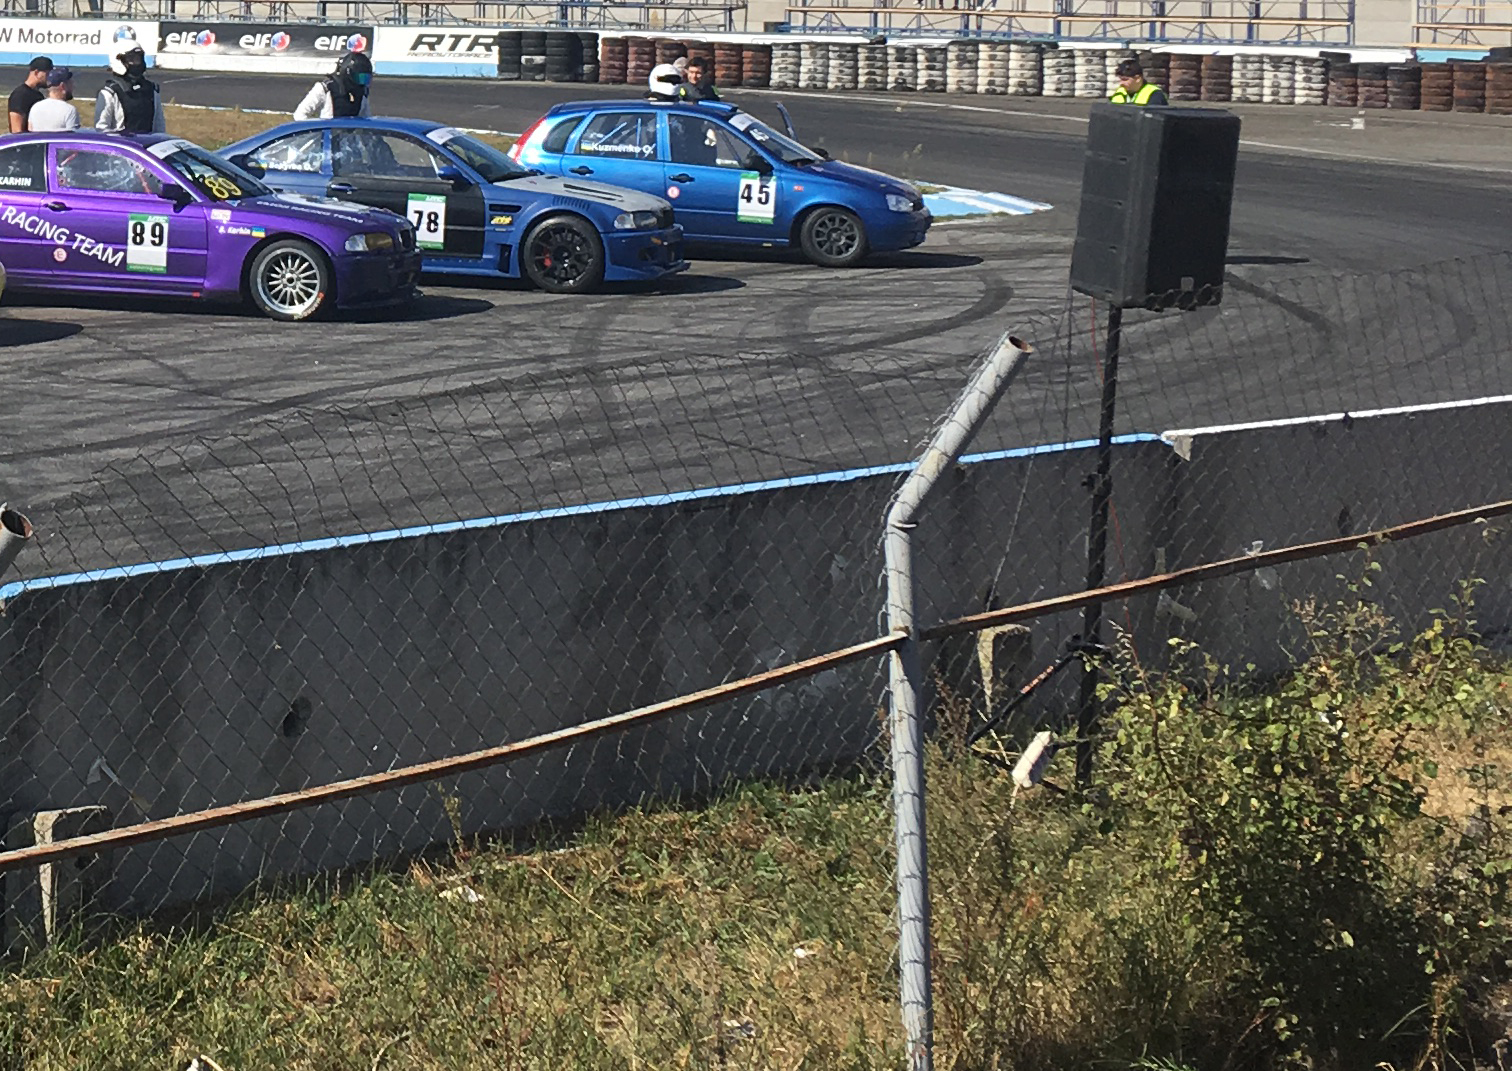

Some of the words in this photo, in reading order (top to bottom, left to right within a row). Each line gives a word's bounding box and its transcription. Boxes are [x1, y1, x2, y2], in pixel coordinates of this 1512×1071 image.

[18, 28, 101, 45] Motorrad
[166, 30, 198, 47] elf
[239, 33, 271, 50] elf
[314, 34, 347, 52] elf
[409, 34, 498, 52] RTR
[591, 143, 641, 153] Kuzmenko
[740, 184, 770, 205] 45
[413, 210, 439, 233] 78
[1, 206, 70, 244] RACING
[72, 233, 125, 267] TEAM
[132, 221, 164, 247] 89
